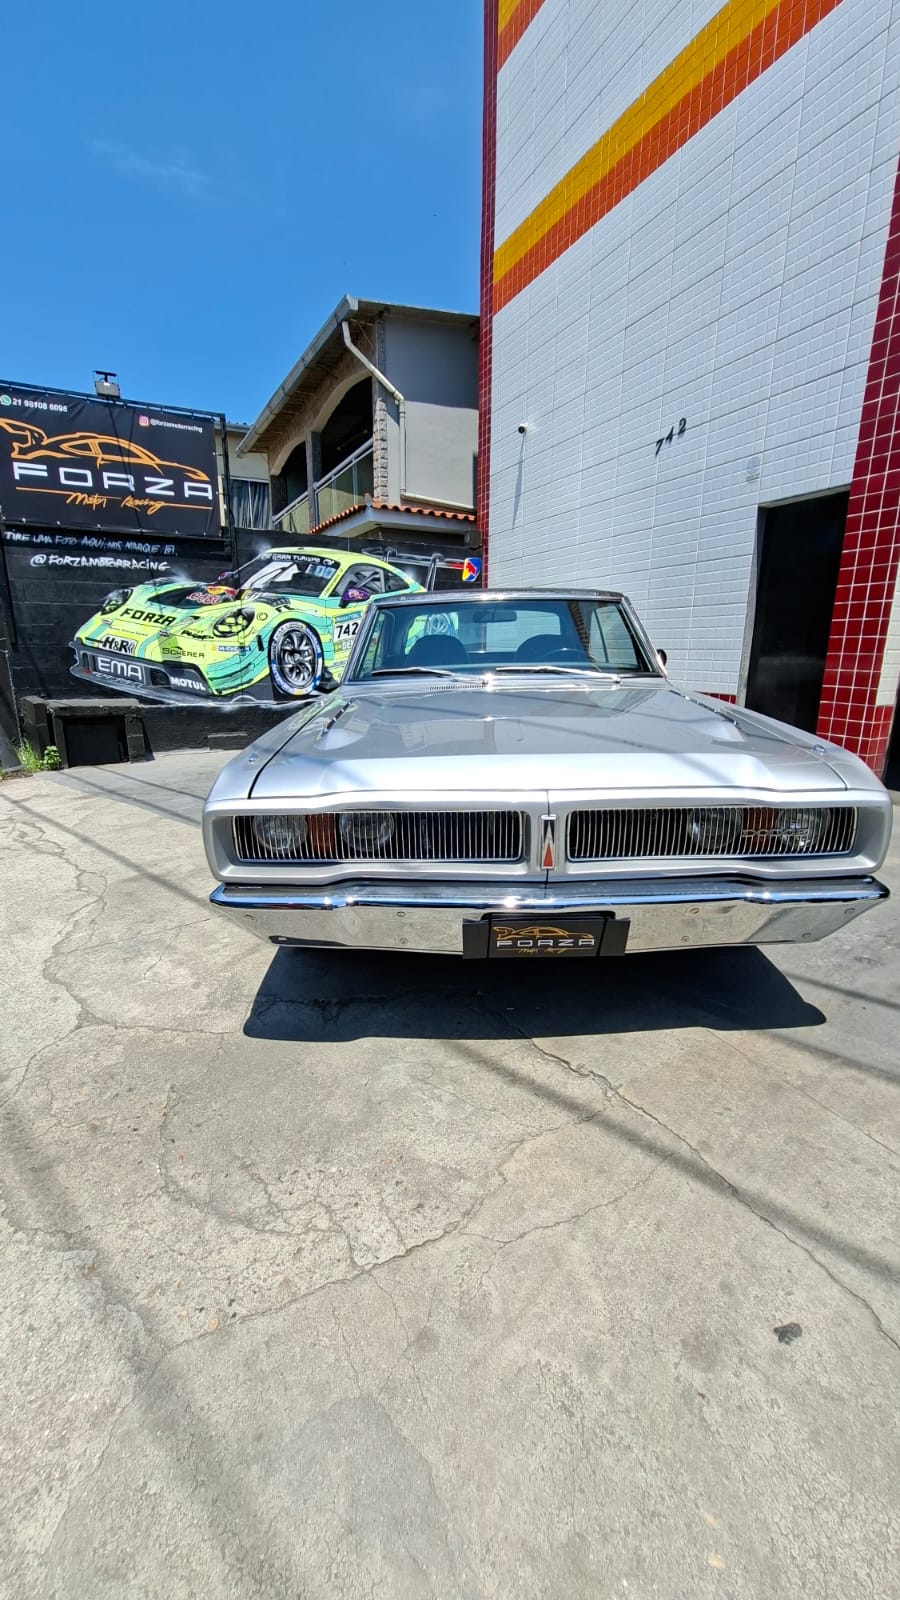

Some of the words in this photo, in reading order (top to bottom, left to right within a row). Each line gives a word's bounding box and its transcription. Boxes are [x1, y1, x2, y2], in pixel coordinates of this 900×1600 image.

[12, 398, 22, 406] 21
[655, 417, 687, 457] 742
[12, 461, 213, 500] FORZA
[119, 607, 178, 627] FORZA
[335, 622, 359, 638] 742
[102, 636, 131, 654] H&R
[97, 657, 142, 681] EMA
[170, 676, 207, 691] MOTUL
[496, 938, 594, 948] FORZA
